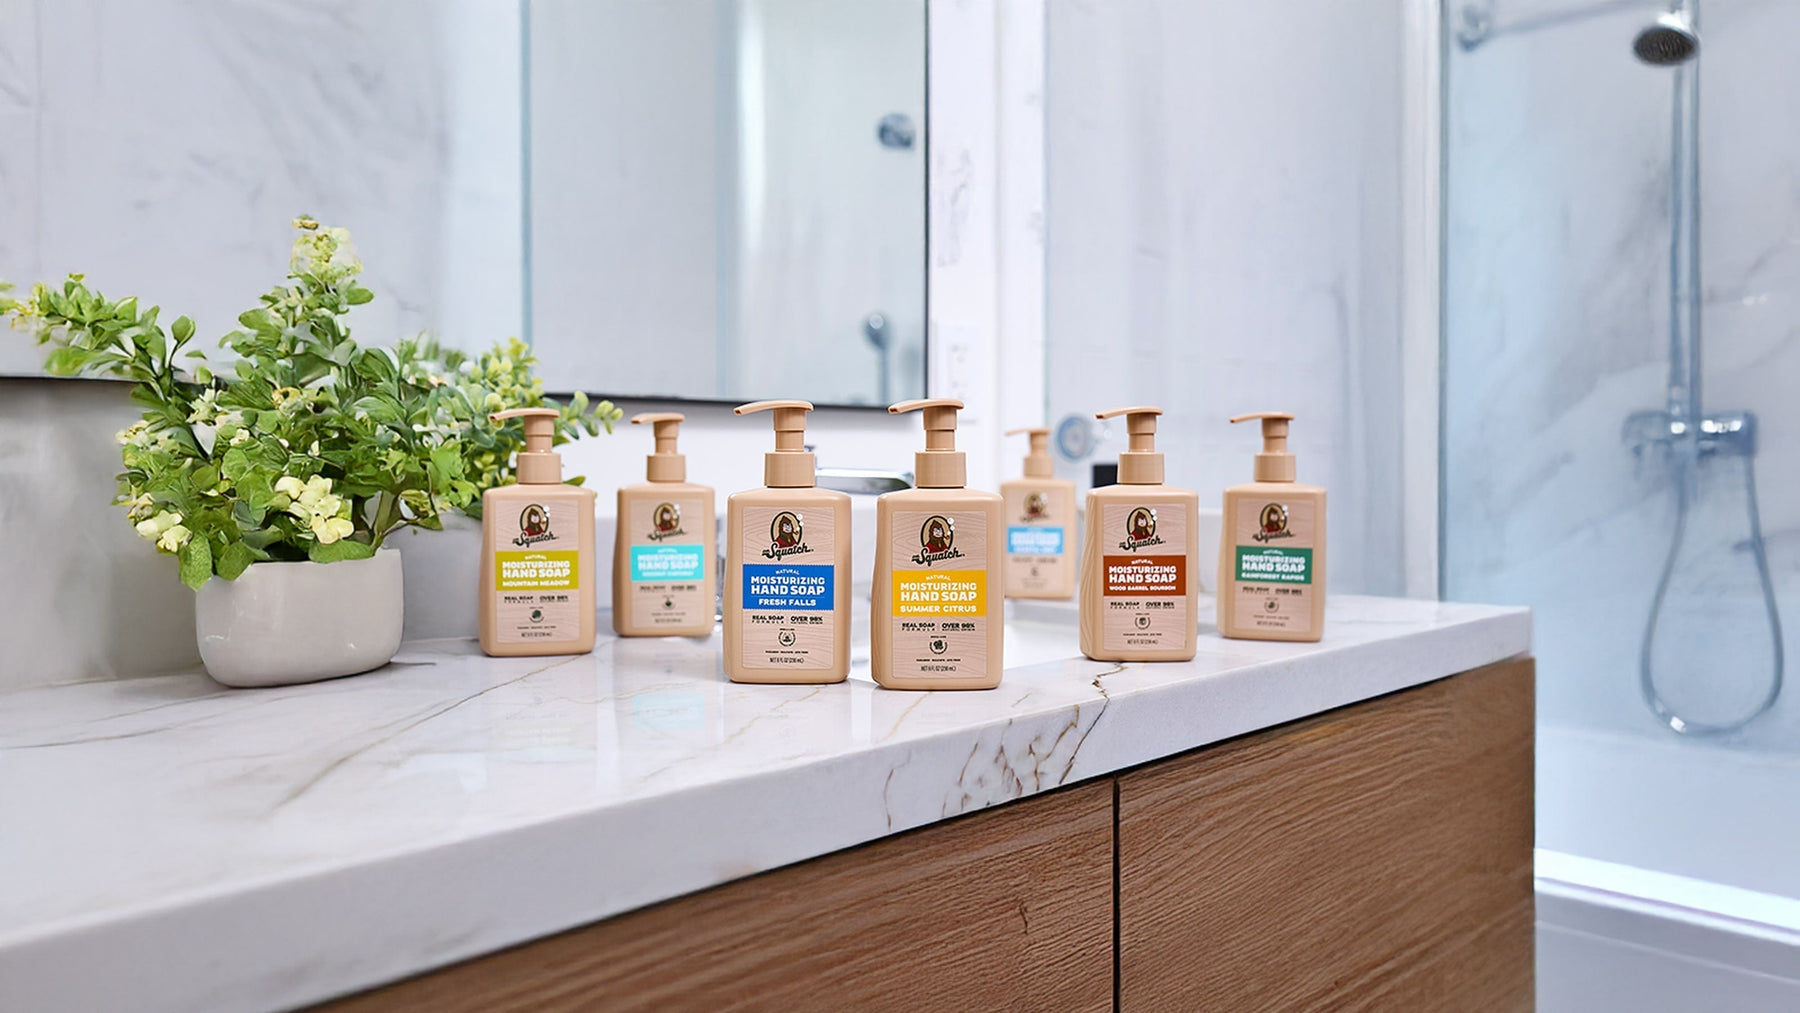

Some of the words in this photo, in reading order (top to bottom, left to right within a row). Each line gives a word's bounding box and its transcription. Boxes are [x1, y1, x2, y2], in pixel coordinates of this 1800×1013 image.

[1125, 535, 1164, 552] Squatch
[767, 542, 811, 561] Squatch
[917, 547, 963, 567] Squatch
[1242, 554, 1306, 564] MOISTURIZING
[502, 560, 571, 569] MOISTURIZING
[1108, 565, 1177, 574] MOISTURIZING
[1242, 562, 1273, 571] HAND
[1275, 563, 1306, 573] SOAP
[502, 569, 538, 578] HAND
[538, 568, 571, 577] SOAP
[1109, 573, 1143, 583] HAND
[1144, 573, 1177, 583] SOAP
[750, 576, 826, 585] MOISTURIZING
[751, 584, 789, 595] HAND
[790, 585, 826, 596] SOAP
[900, 582, 977, 591] MOISTURIZING
[900, 591, 940, 601] HAND
[941, 591, 977, 602] SOAP
[758, 598, 787, 606] FRESH
[789, 598, 817, 607] FALLS
[900, 605, 940, 613] SUMMER
[943, 605, 977, 613] CITRUS
